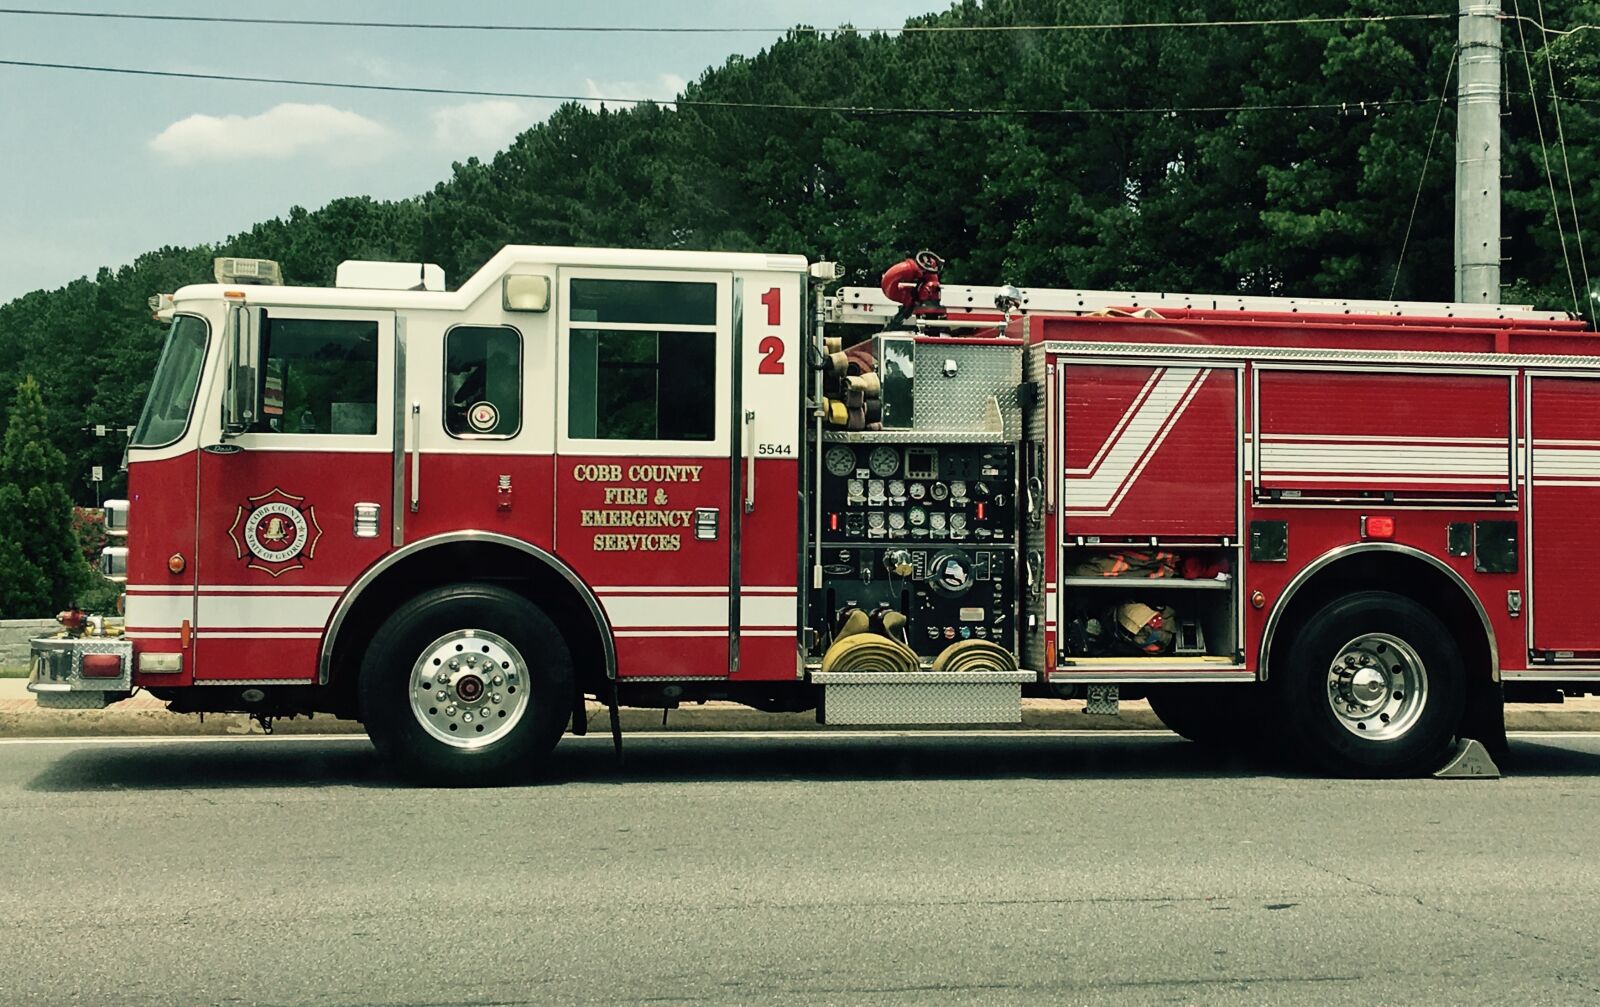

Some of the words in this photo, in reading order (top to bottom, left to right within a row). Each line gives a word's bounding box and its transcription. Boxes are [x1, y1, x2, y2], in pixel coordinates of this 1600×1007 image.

[758, 444, 792, 455] 5544
[573, 464, 623, 482] COBB
[628, 465, 703, 482] COUNTY
[604, 487, 648, 505] FIRE
[653, 487, 668, 505] &
[249, 506, 270, 525] COBB
[271, 505, 302, 524] COUNTY
[580, 510, 693, 527] EMERGENCY
[248, 534, 263, 555] STATE
[263, 552, 273, 560] OF
[275, 534, 305, 560] GEORGIA
[593, 534, 681, 551] SERVICES
